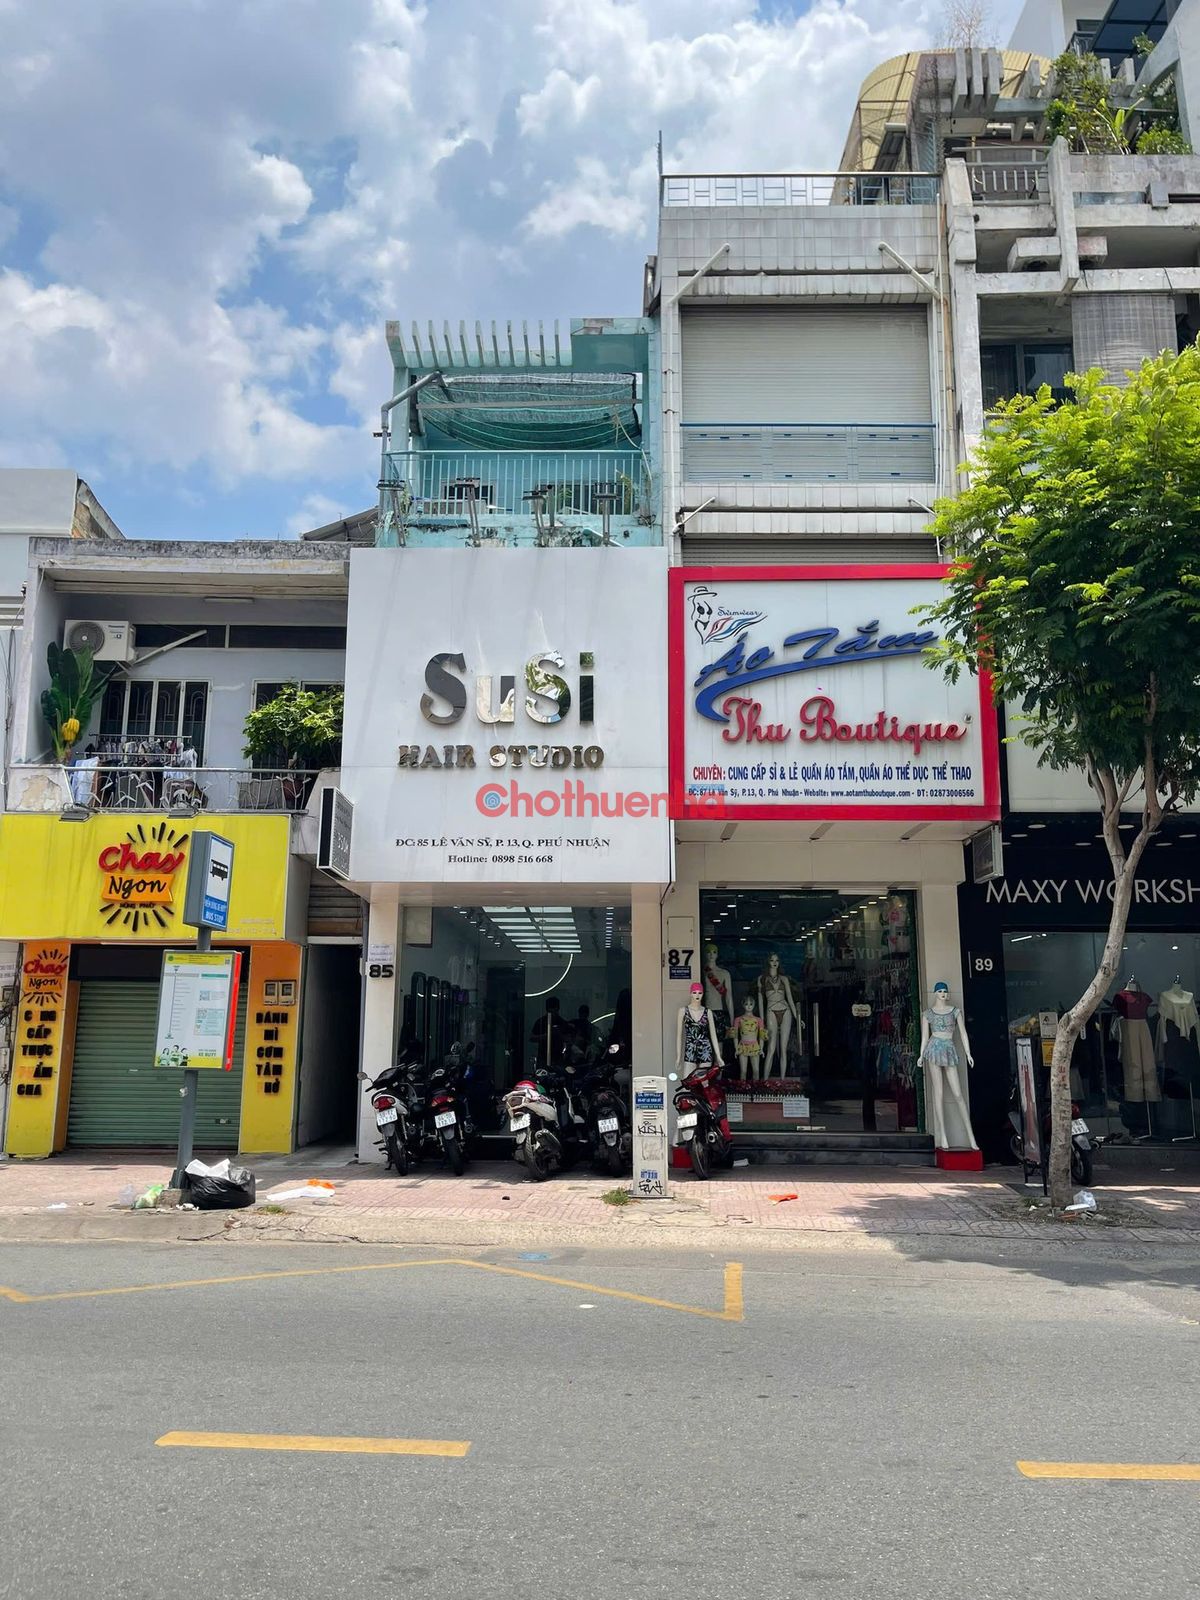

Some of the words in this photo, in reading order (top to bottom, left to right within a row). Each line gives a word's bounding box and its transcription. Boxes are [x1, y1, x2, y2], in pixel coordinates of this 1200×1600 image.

[721, 696, 791, 744] Thu
[799, 695, 967, 756] Boutique
[397, 745, 476, 768] HAIR
[488, 745, 605, 768] STUDIO
[692, 763, 726, 781] CHUYÊN:
[728, 765, 748, 781] CUNG
[751, 761, 766, 781] CẤP
[779, 765, 786, 781] &
[789, 761, 798, 781] LẺ
[801, 762, 822, 782] QUẦN
[824, 762, 835, 781] ÁO
[882, 762, 893, 781] ÁO
[895, 761, 911, 781] THỂ
[912, 765, 929, 783] DỤC
[932, 761, 948, 781] THỂ
[950, 765, 972, 781] THAO
[758, 788, 766, 797] Q.
[768, 788, 779, 797] Phú
[804, 788, 829, 797] Website:
[431, 836, 448, 847] LÊ
[450, 837, 475, 847] VĂN
[495, 838, 505, 847] P.
[522, 838, 534, 849] Q.
[537, 836, 563, 847] PHÚ
[566, 836, 611, 850] NHUẬN
[98, 842, 186, 874] Chay
[448, 854, 488, 864] Hotline:
[491, 855, 515, 864] 0898
[517, 855, 534, 864] 516
[535, 855, 554, 864] 668
[108, 875, 166, 899] Ngon
[985, 879, 1068, 904] MAXY
[205, 910, 214, 921] BUS
[213, 913, 224, 924] STOP
[668, 949, 694, 966] 87
[974, 957, 994, 972] 89
[24, 959, 67, 976] Chay
[369, 964, 394, 978] 85
[29, 976, 58, 990] Ngon
